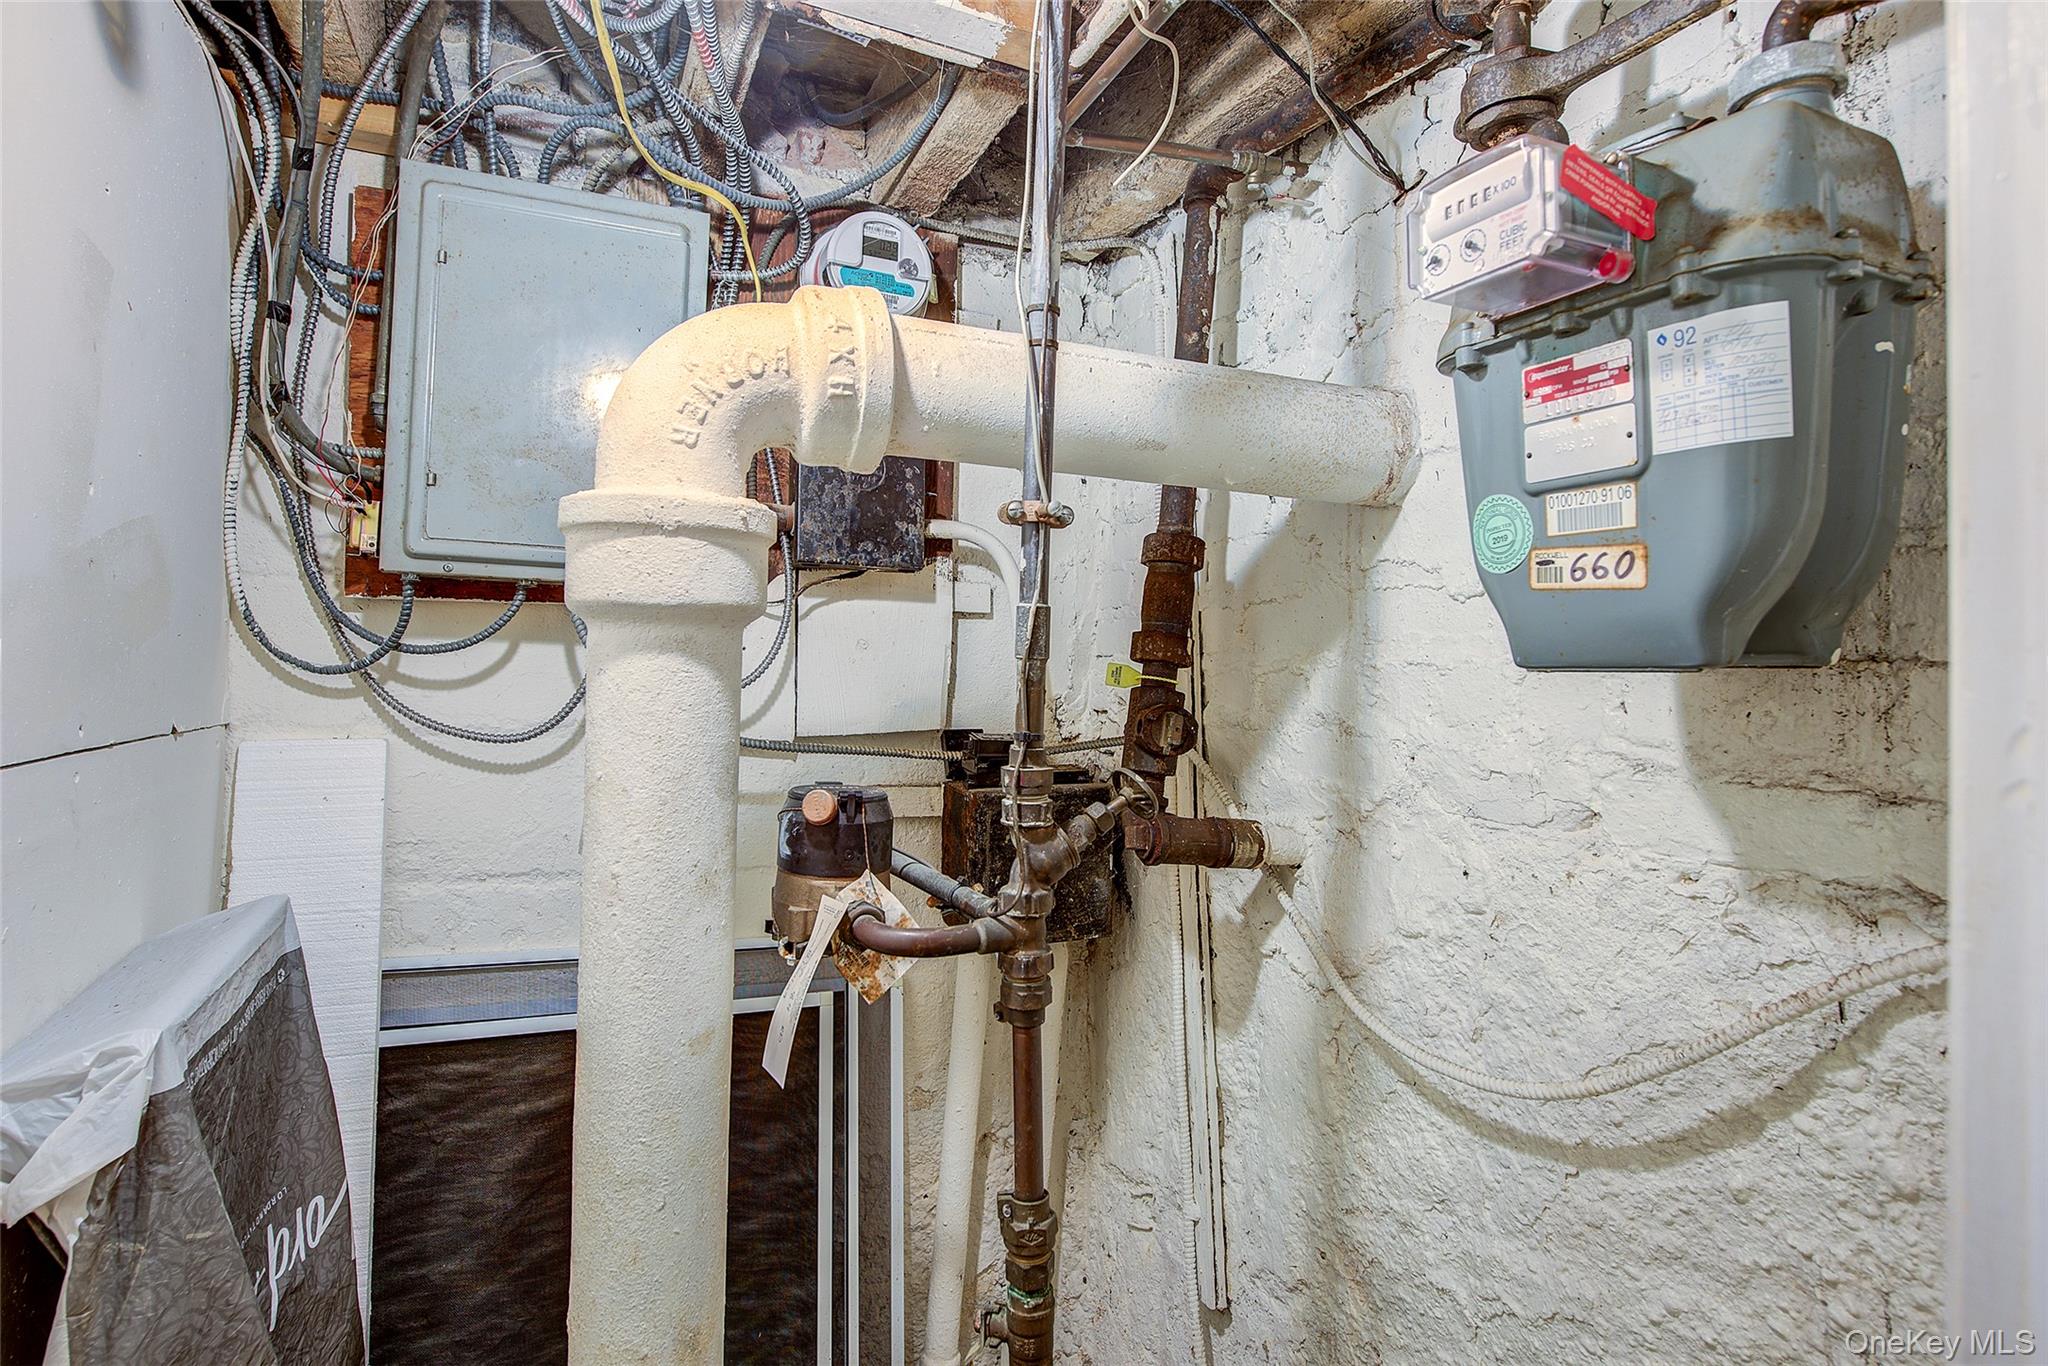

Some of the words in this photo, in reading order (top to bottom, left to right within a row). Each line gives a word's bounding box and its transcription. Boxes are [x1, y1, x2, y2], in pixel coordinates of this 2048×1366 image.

[1499, 220, 1528, 239] CUBIC
[1499, 236, 1525, 251] FEET
[1673, 326, 1697, 348] 92
[1548, 489, 1598, 509] 01001270
[1601, 488, 1614, 503] 91
[1617, 485, 1632, 501] 06
[1492, 534, 1508, 545] 2019
[1570, 550, 1636, 583] 660
